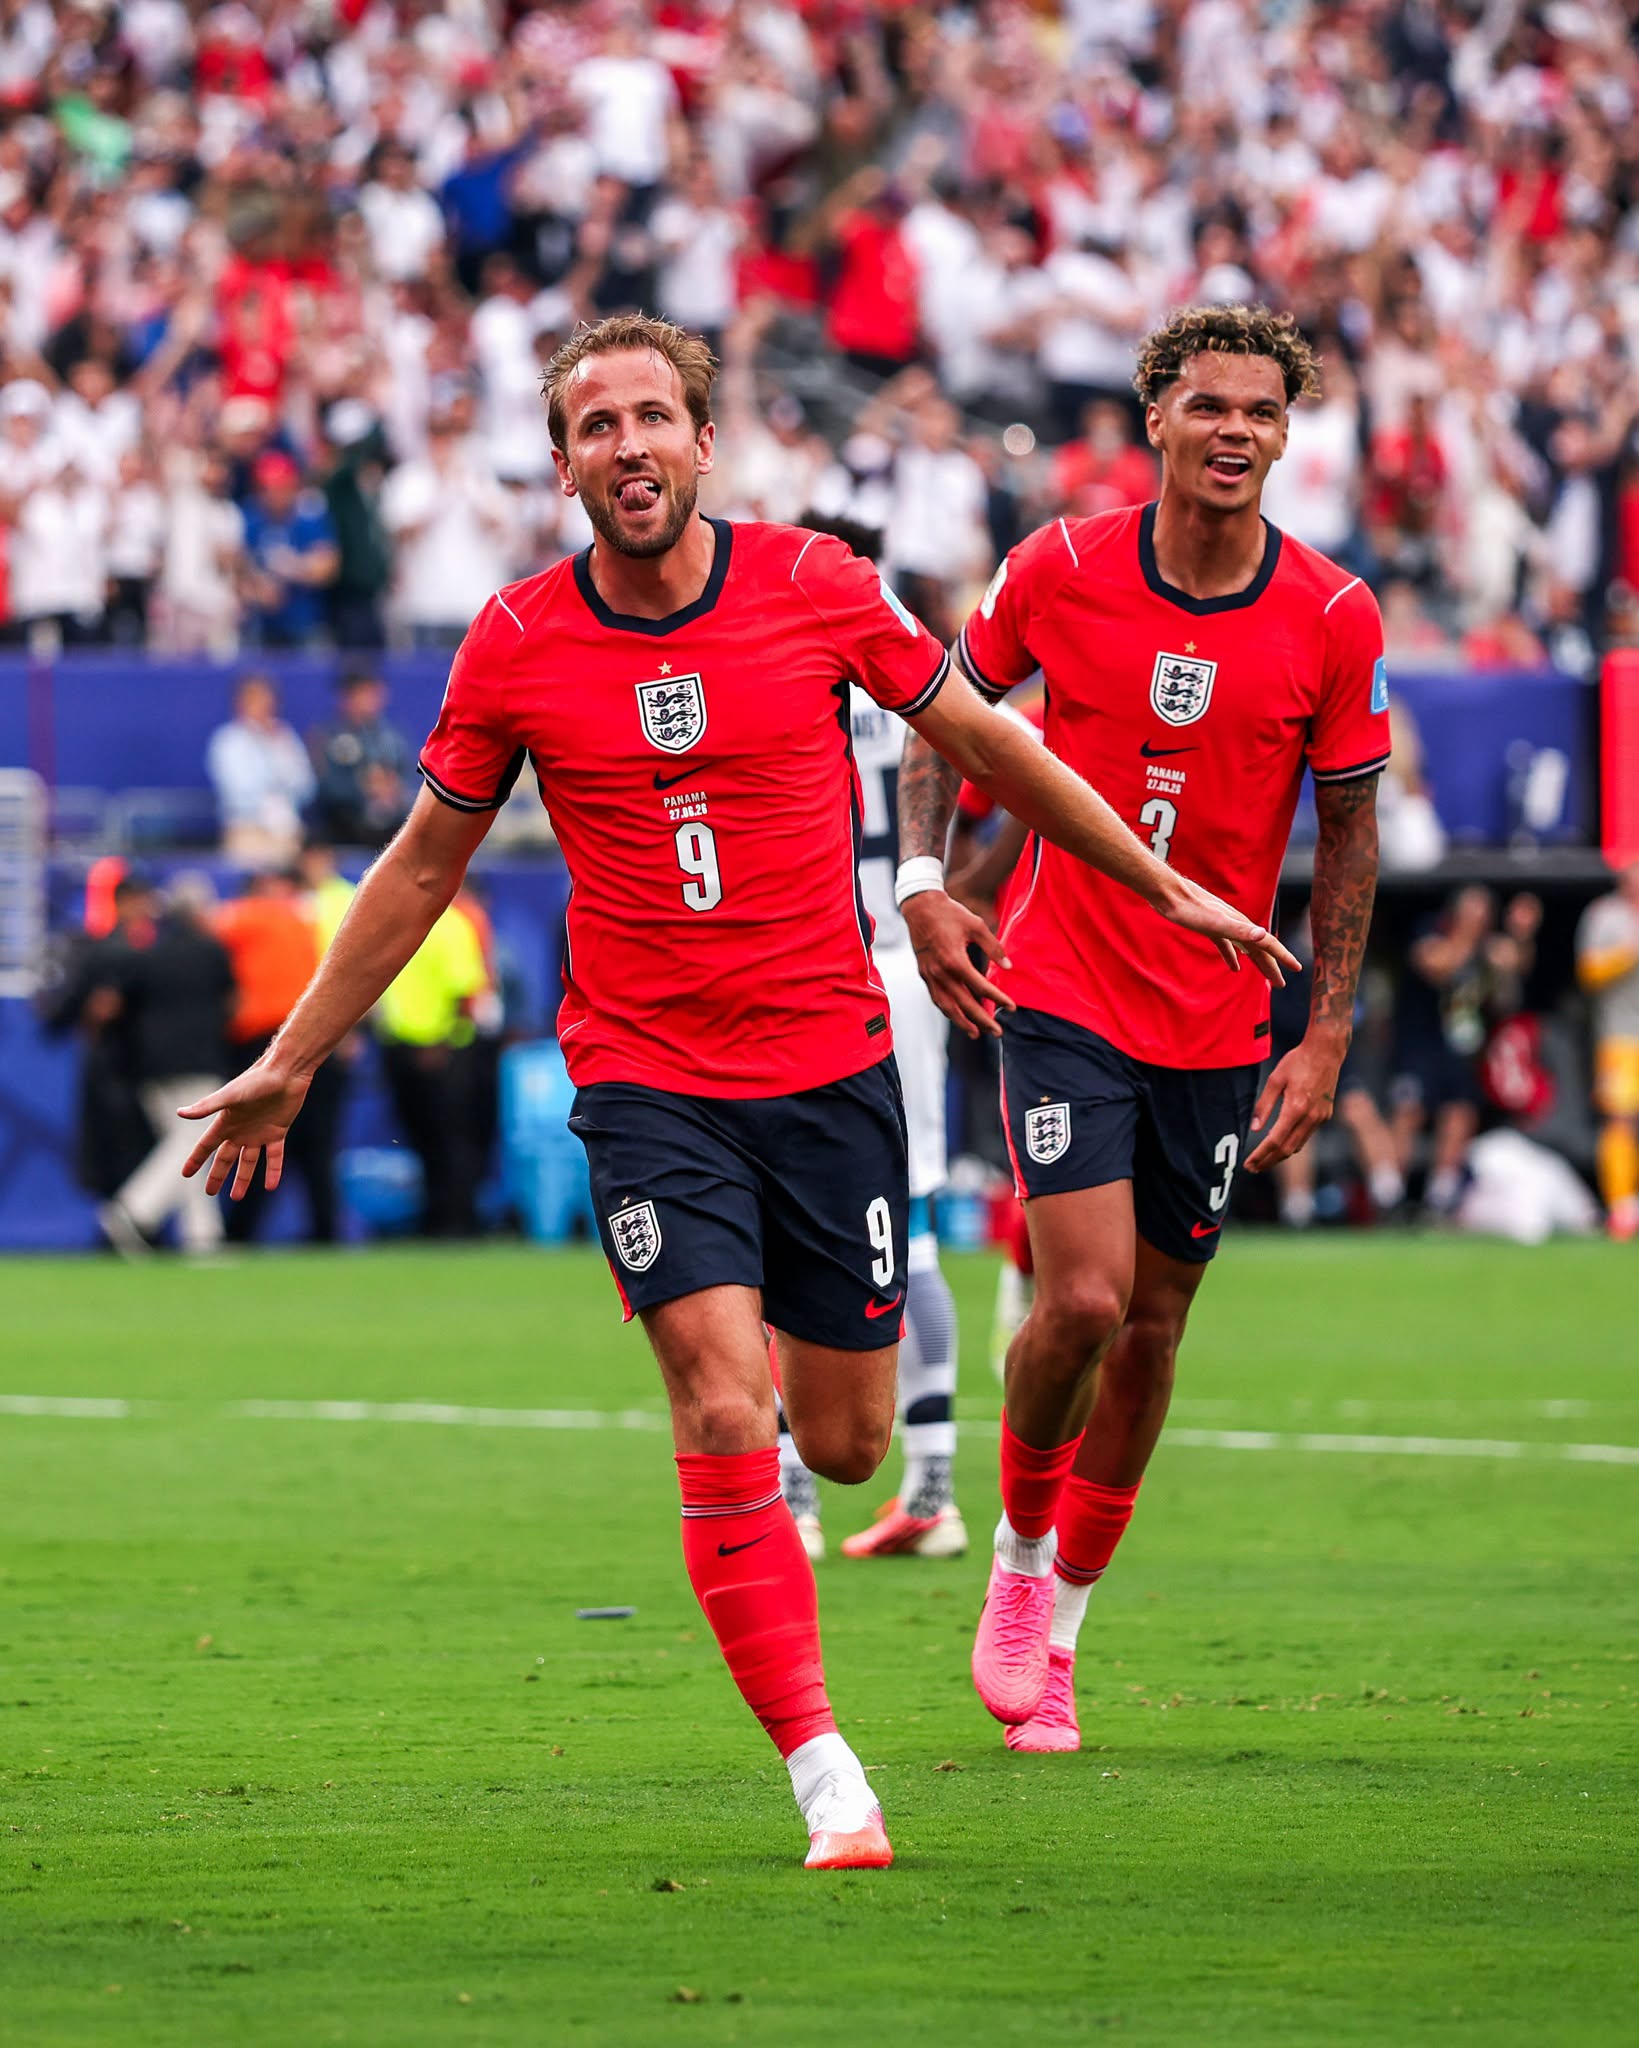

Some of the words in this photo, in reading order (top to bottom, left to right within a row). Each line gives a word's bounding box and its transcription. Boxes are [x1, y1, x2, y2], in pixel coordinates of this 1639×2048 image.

[663, 791, 707, 808] PANAMA
[1146, 764, 1186, 783] PANAMA
[669, 803, 708, 820] 27.06.26
[1139, 798, 1178, 863] 3
[675, 822, 722, 912] 9
[1209, 1133, 1239, 1212] 3
[866, 1196, 894, 1288] 9
